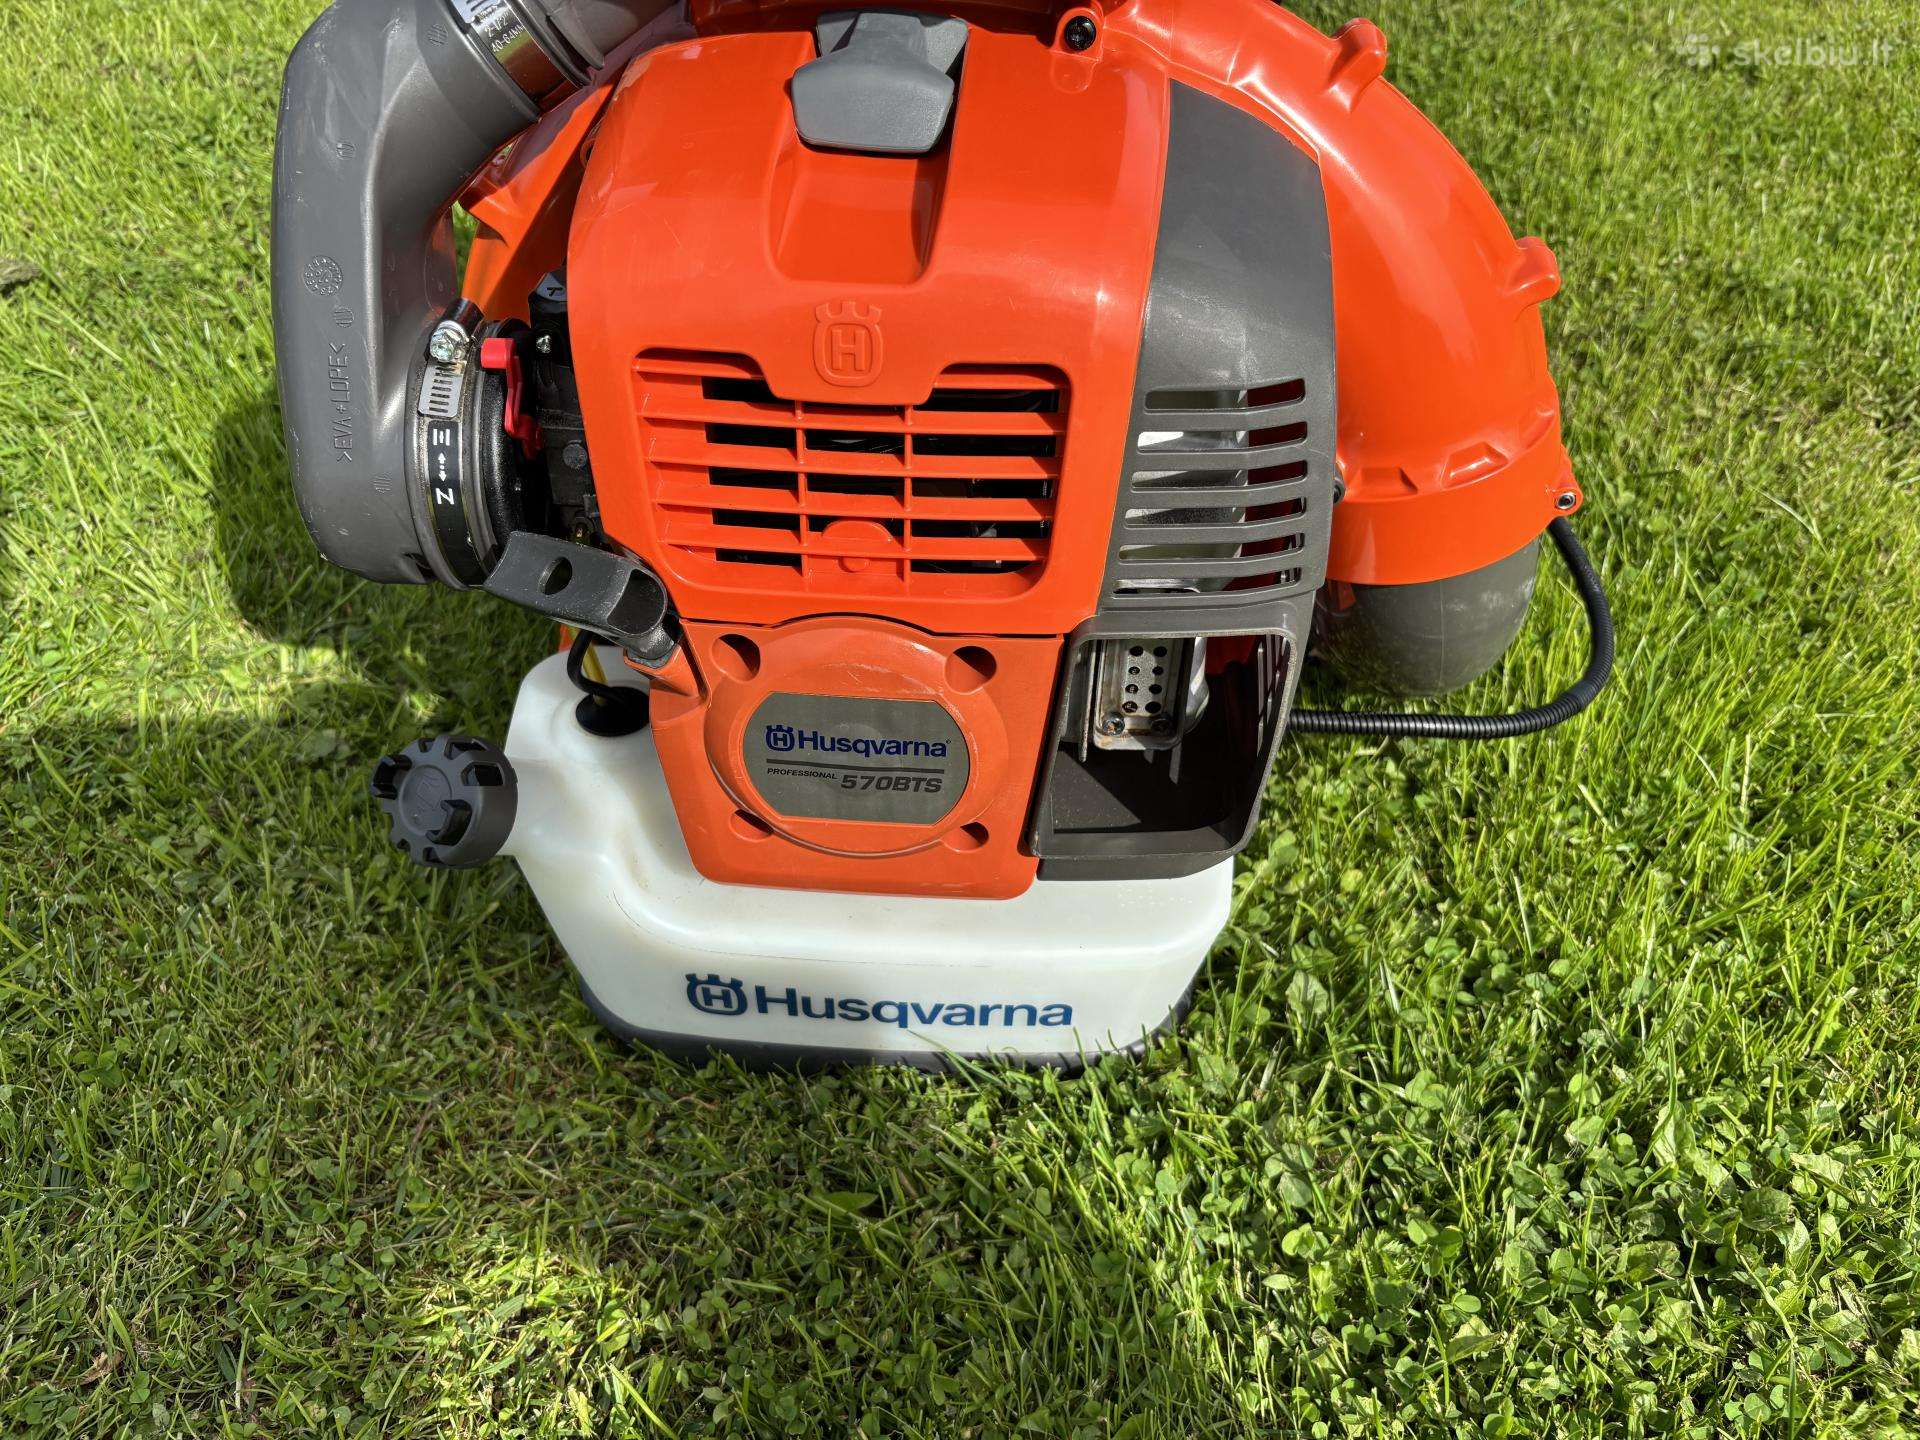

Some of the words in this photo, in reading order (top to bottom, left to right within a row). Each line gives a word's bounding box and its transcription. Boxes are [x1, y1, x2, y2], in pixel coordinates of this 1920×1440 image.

[767, 767, 838, 780] PROFESSIONAL
[841, 774, 943, 793] 570BTS
[754, 985, 1073, 1029] Husqvarna
